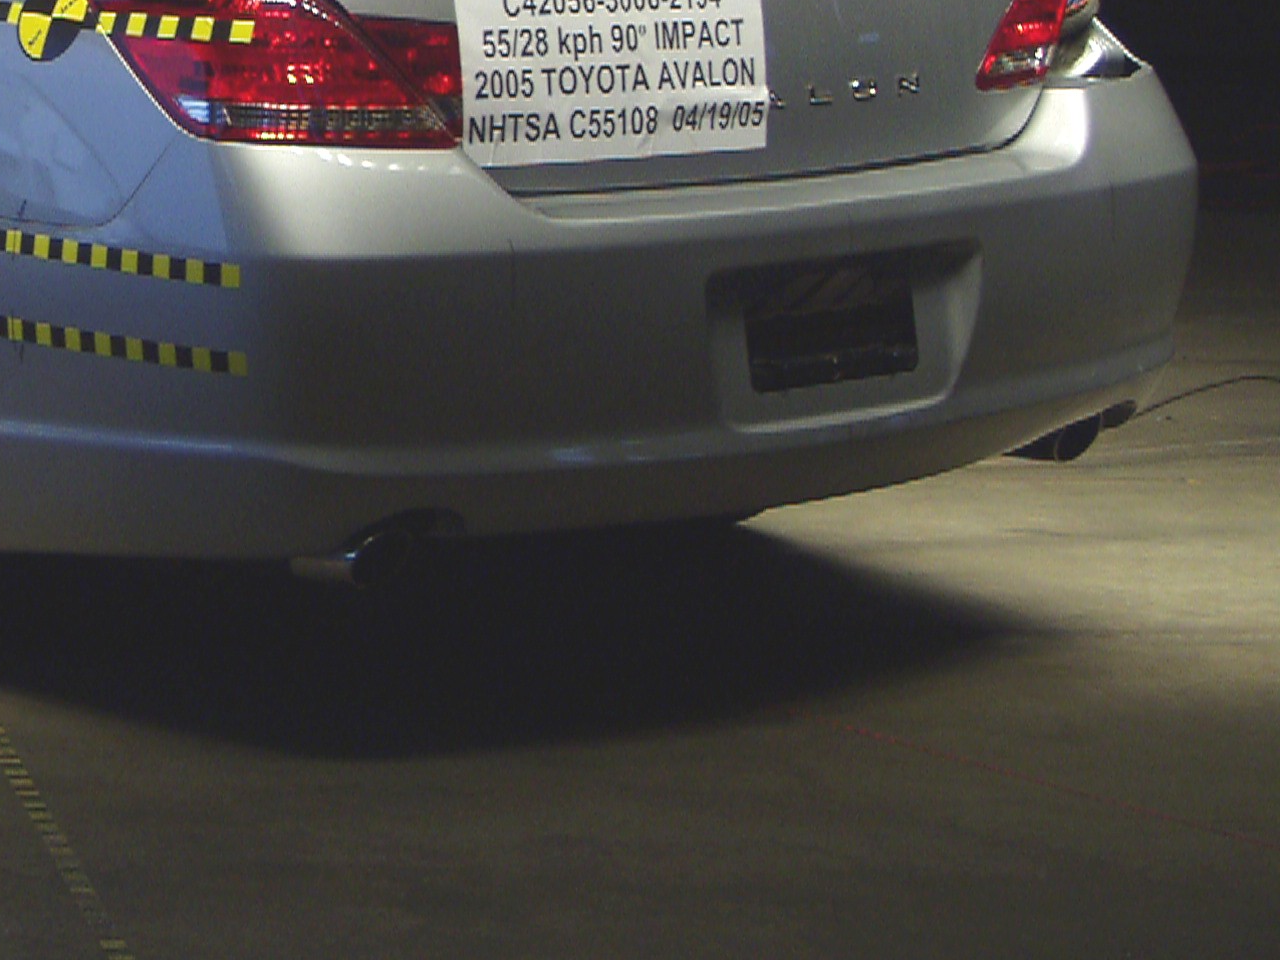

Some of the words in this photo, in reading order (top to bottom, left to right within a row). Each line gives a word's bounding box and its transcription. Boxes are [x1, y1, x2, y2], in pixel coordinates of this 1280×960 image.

[482, 28, 549, 60] 55/28
[557, 24, 603, 62] kph
[654, 18, 745, 52] IMPACT
[474, 68, 535, 100] 2005
[540, 62, 650, 96] TOYOTA
[657, 57, 756, 91] AVALON
[468, 112, 561, 145] NHTSA
[569, 105, 659, 139] C55108
[671, 100, 766, 133] 04/19/05
